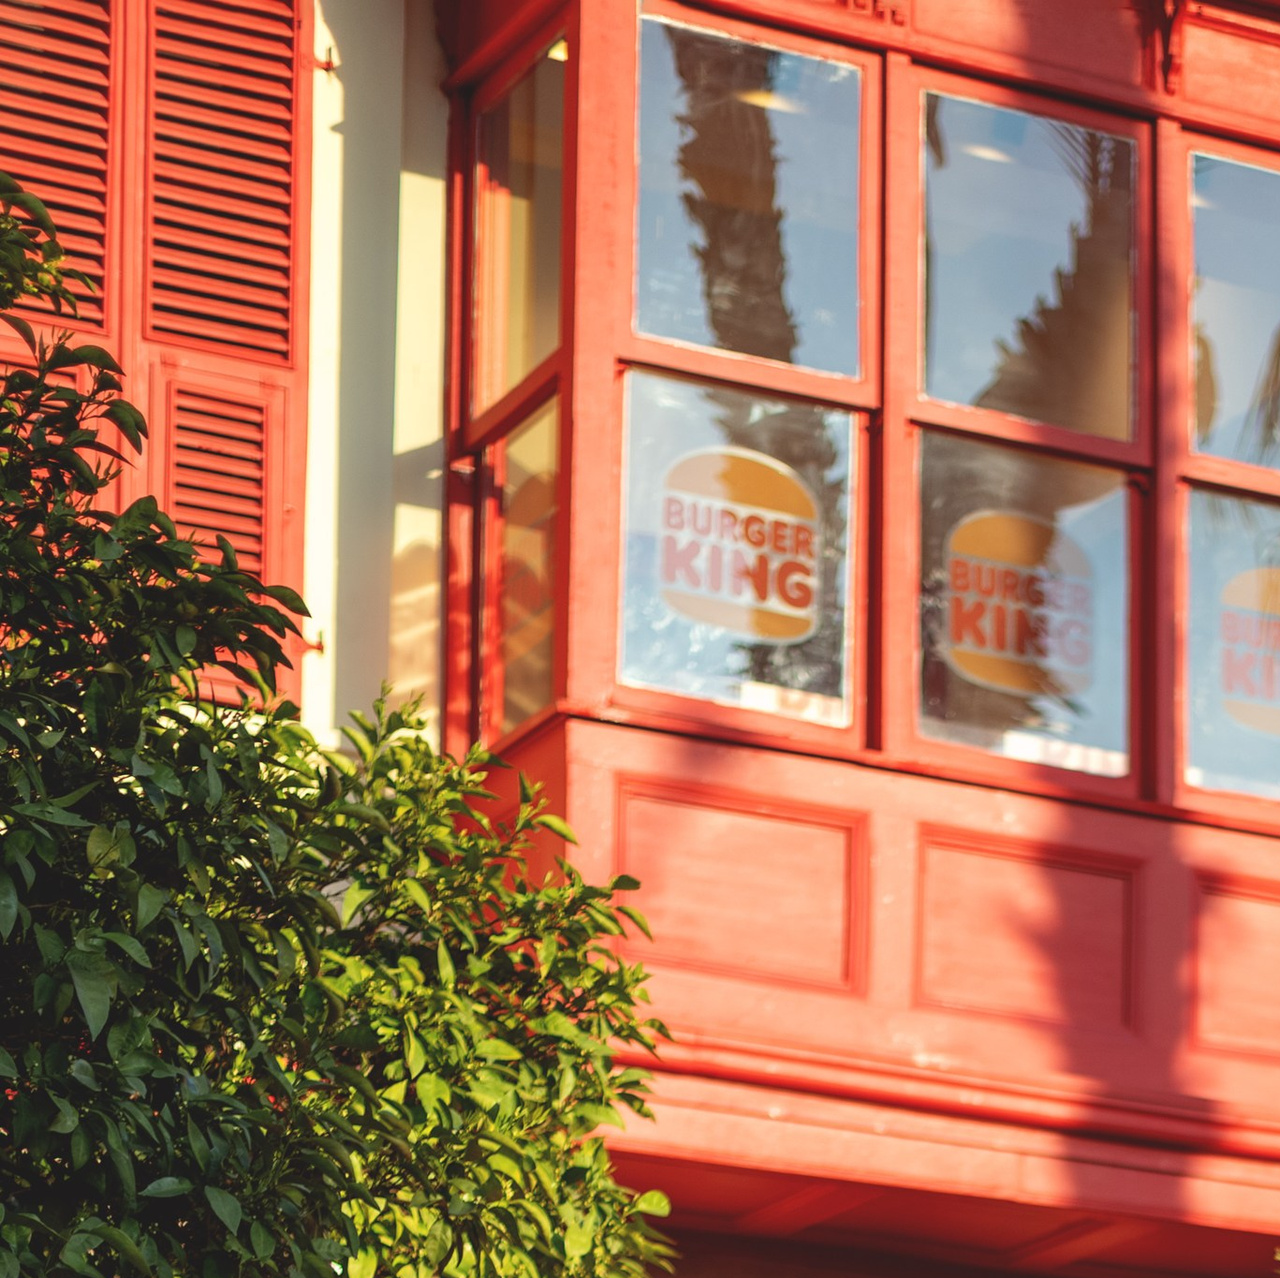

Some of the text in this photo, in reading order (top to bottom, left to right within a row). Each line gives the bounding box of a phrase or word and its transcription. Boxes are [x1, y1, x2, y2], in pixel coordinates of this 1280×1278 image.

[665, 497, 814, 559] BURGER
[663, 535, 814, 608] KING
[950, 558, 1091, 618] BURGER
[950, 595, 1091, 666] KING
